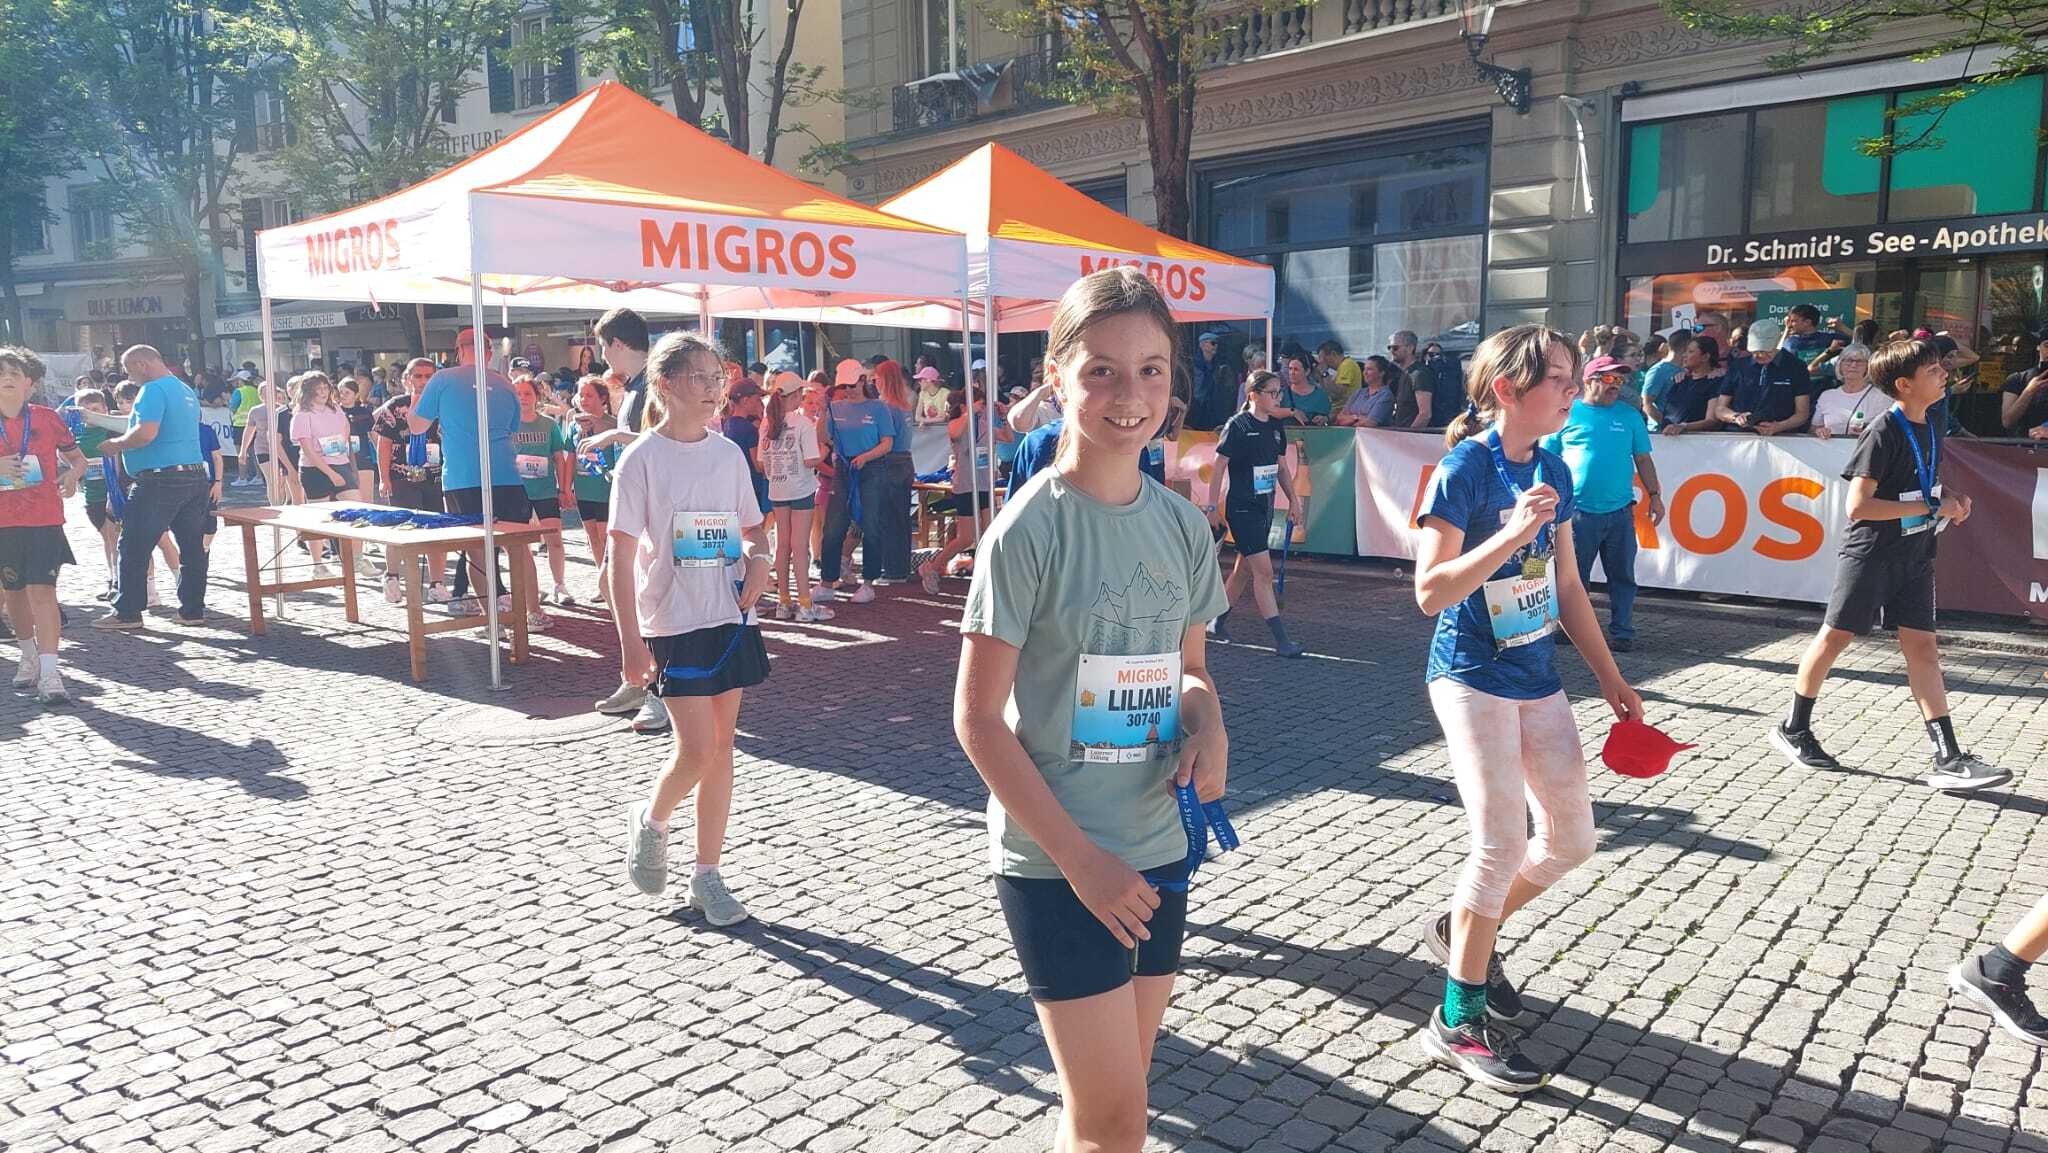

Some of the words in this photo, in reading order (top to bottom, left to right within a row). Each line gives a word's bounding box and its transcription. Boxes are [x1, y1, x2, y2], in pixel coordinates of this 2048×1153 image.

[306, 218, 400, 276] MIGROS
[640, 219, 857, 279] MIGROS
[1707, 244, 1737, 265] Dr.
[1080, 254, 1206, 301] MROS
[118, 295, 162, 315] LEMON
[300, 312, 334, 329] POUSHE
[697, 528, 728, 541] LEVIA
[1512, 576, 1549, 595] MIGR
[1517, 585, 1551, 612] LUCIE
[1118, 667, 1169, 684] MIGROS
[1108, 686, 1172, 712] LILIANE
[1126, 711, 1161, 728] 30740
